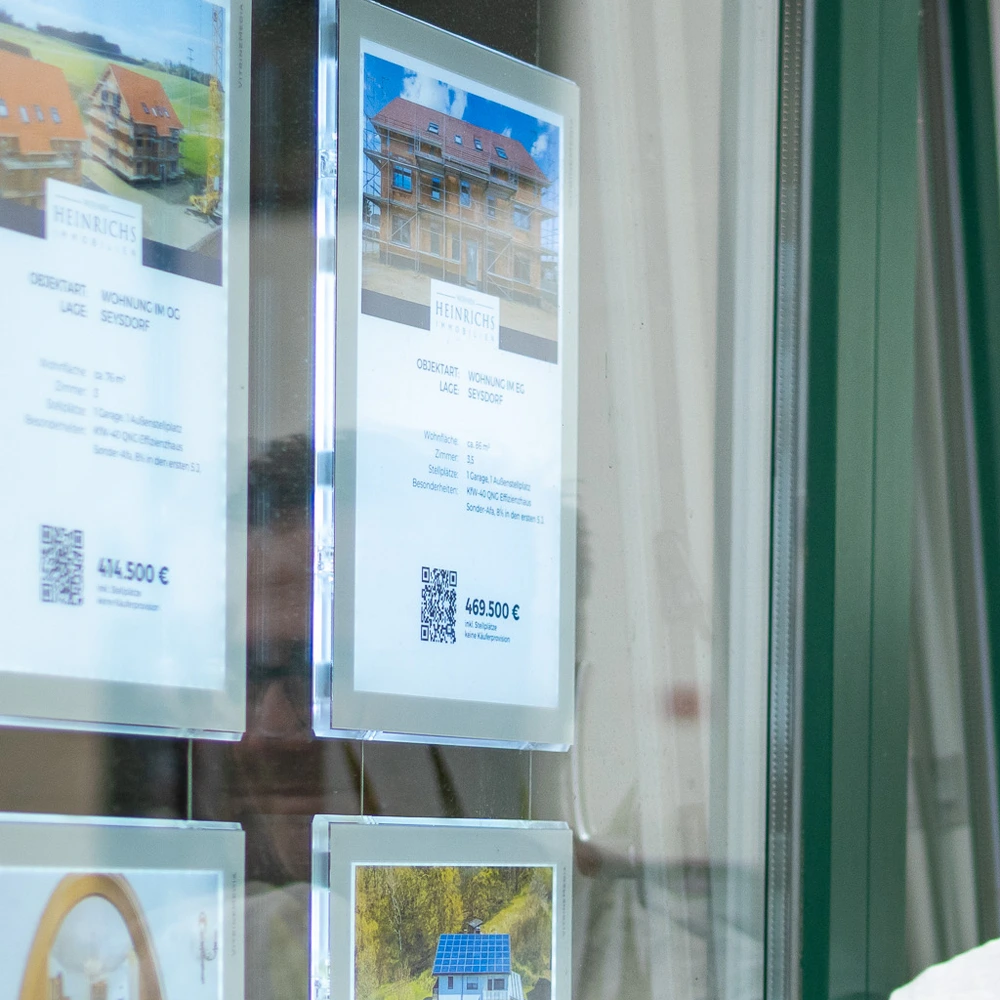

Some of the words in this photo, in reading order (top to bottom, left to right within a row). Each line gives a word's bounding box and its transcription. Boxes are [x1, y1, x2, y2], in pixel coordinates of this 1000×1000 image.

[54, 205, 136, 243] HEINRICHS
[101, 289, 153, 314] WOHNUNG
[154, 303, 165, 316] IM
[167, 306, 181, 320] OG
[436, 301, 495, 330] HEINRICHS
[101, 309, 150, 331] SEYSDORF
[417, 358, 460, 378] OBJEKTART:
[468, 370, 505, 390] WOHNUNG
[506, 380, 515, 391] IM
[516, 383, 525, 395] EG
[439, 381, 460, 396] LAGE:
[468, 388, 504, 405] SEYSDORF
[435, 449, 459, 462] Zimmer:
[412, 478, 459, 496] Besonderheiten:
[98, 558, 155, 584] 414.500
[159, 566, 170, 585] €
[465, 598, 510, 620] 469.500
[512, 604, 520, 621] €
